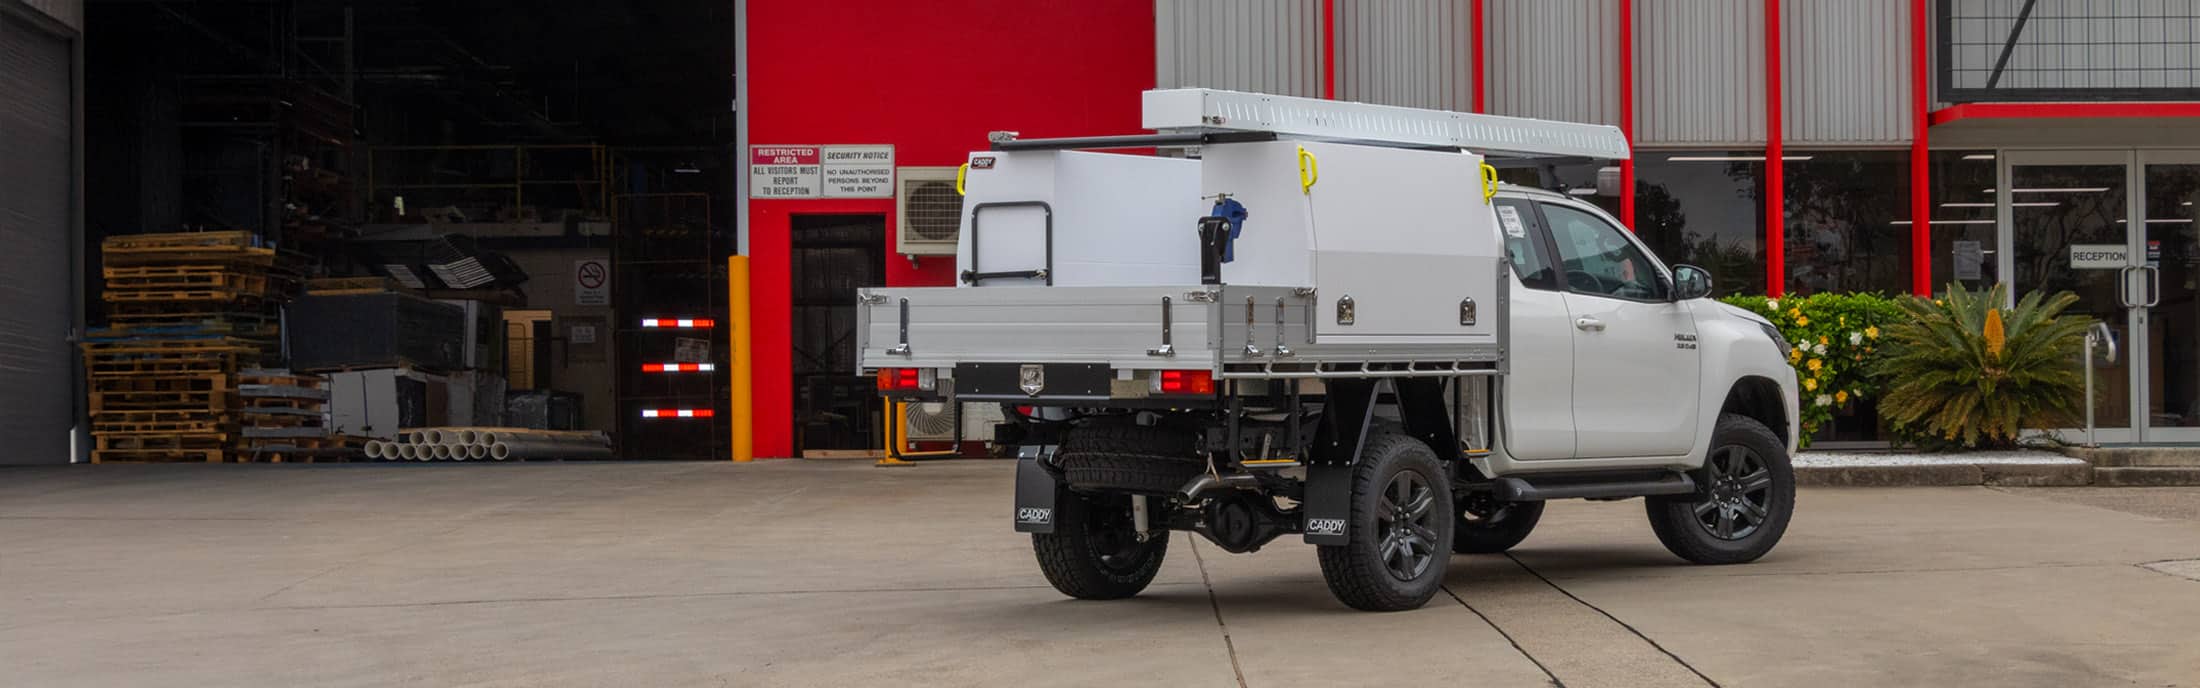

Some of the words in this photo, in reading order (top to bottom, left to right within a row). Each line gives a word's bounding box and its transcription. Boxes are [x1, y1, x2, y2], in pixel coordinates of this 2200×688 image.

[774, 156, 798, 164] AREA
[753, 166, 765, 175] ALL
[768, 166, 798, 175] VISITORS
[800, 166, 818, 175] MUST
[773, 177, 798, 185] REPORT
[763, 187, 771, 195] TO
[773, 186, 810, 195] RECEPTION
[2073, 251, 2126, 261] RECEPTION
[1019, 508, 1051, 520] CADDY
[1309, 519, 1345, 531] CADDY
